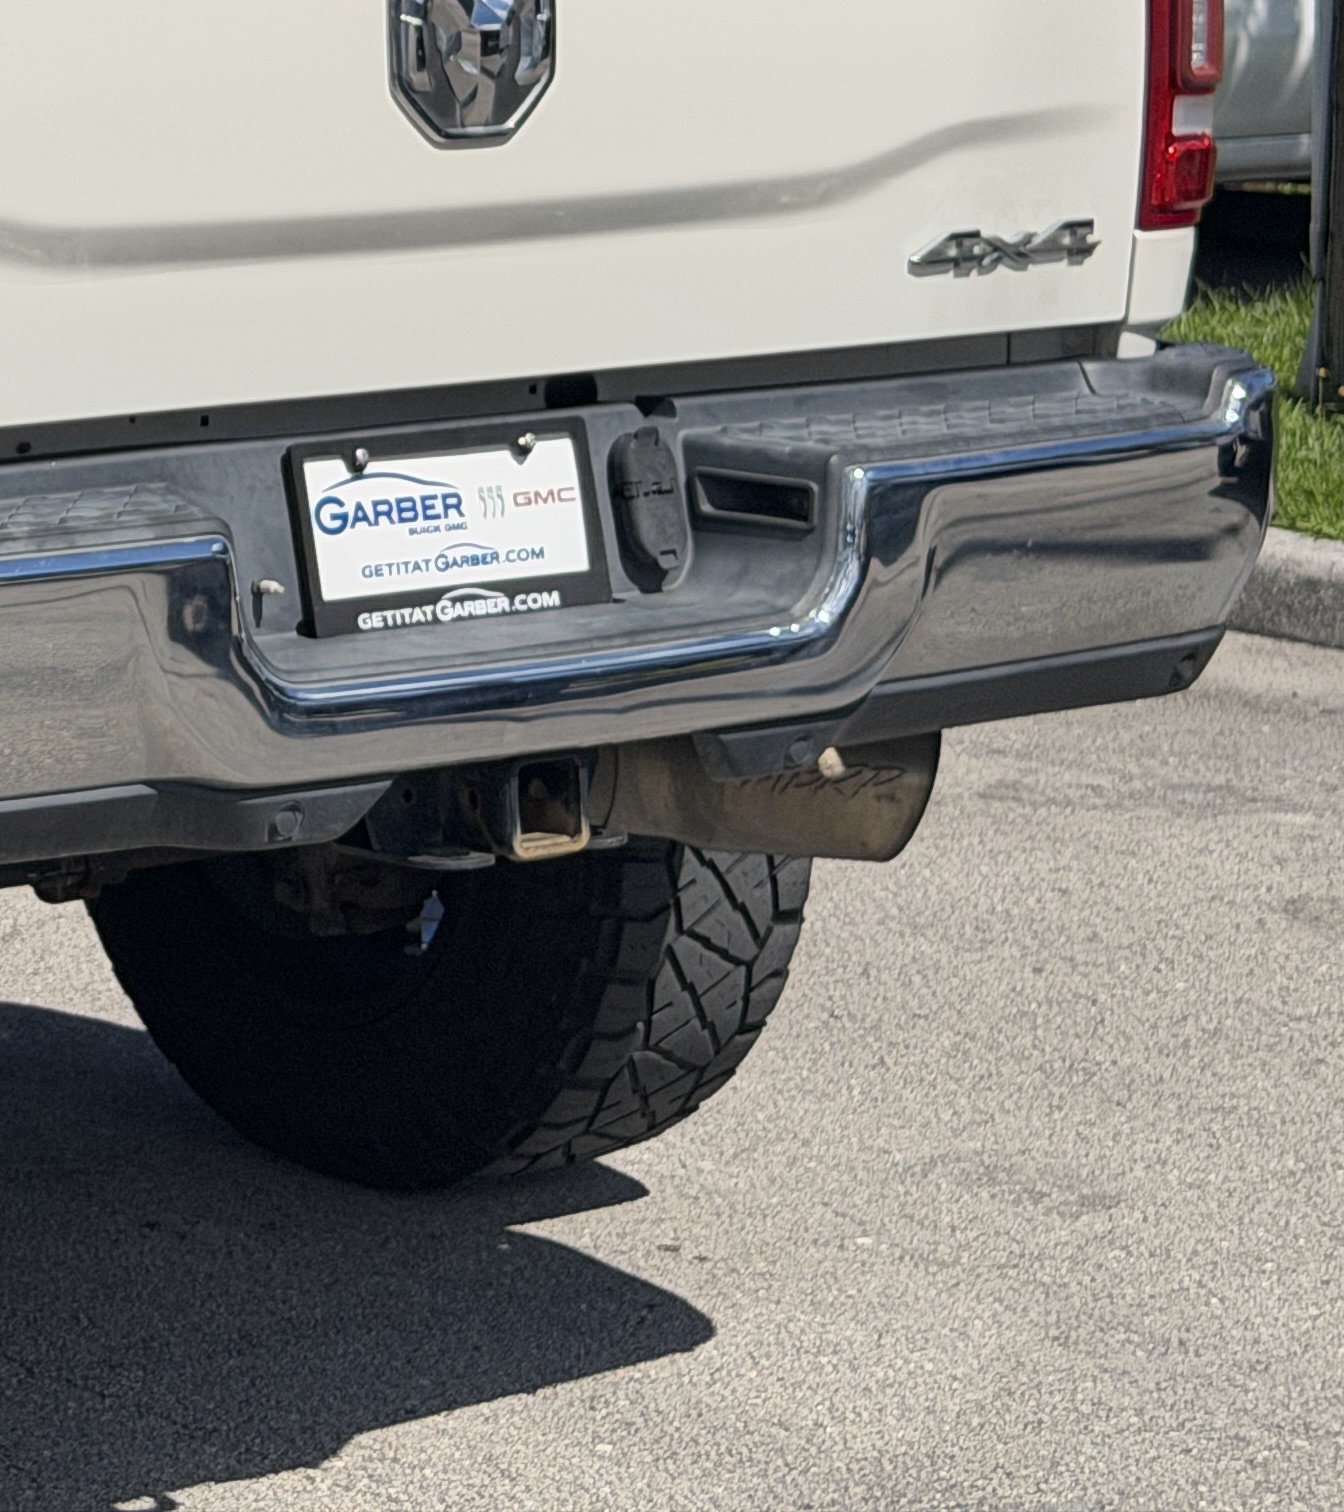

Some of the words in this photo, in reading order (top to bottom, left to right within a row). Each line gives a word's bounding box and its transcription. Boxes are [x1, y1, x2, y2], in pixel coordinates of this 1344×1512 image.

[513, 487, 577, 508] GMC
[408, 524, 441, 536] BUICK
[444, 521, 468, 532] GMC
